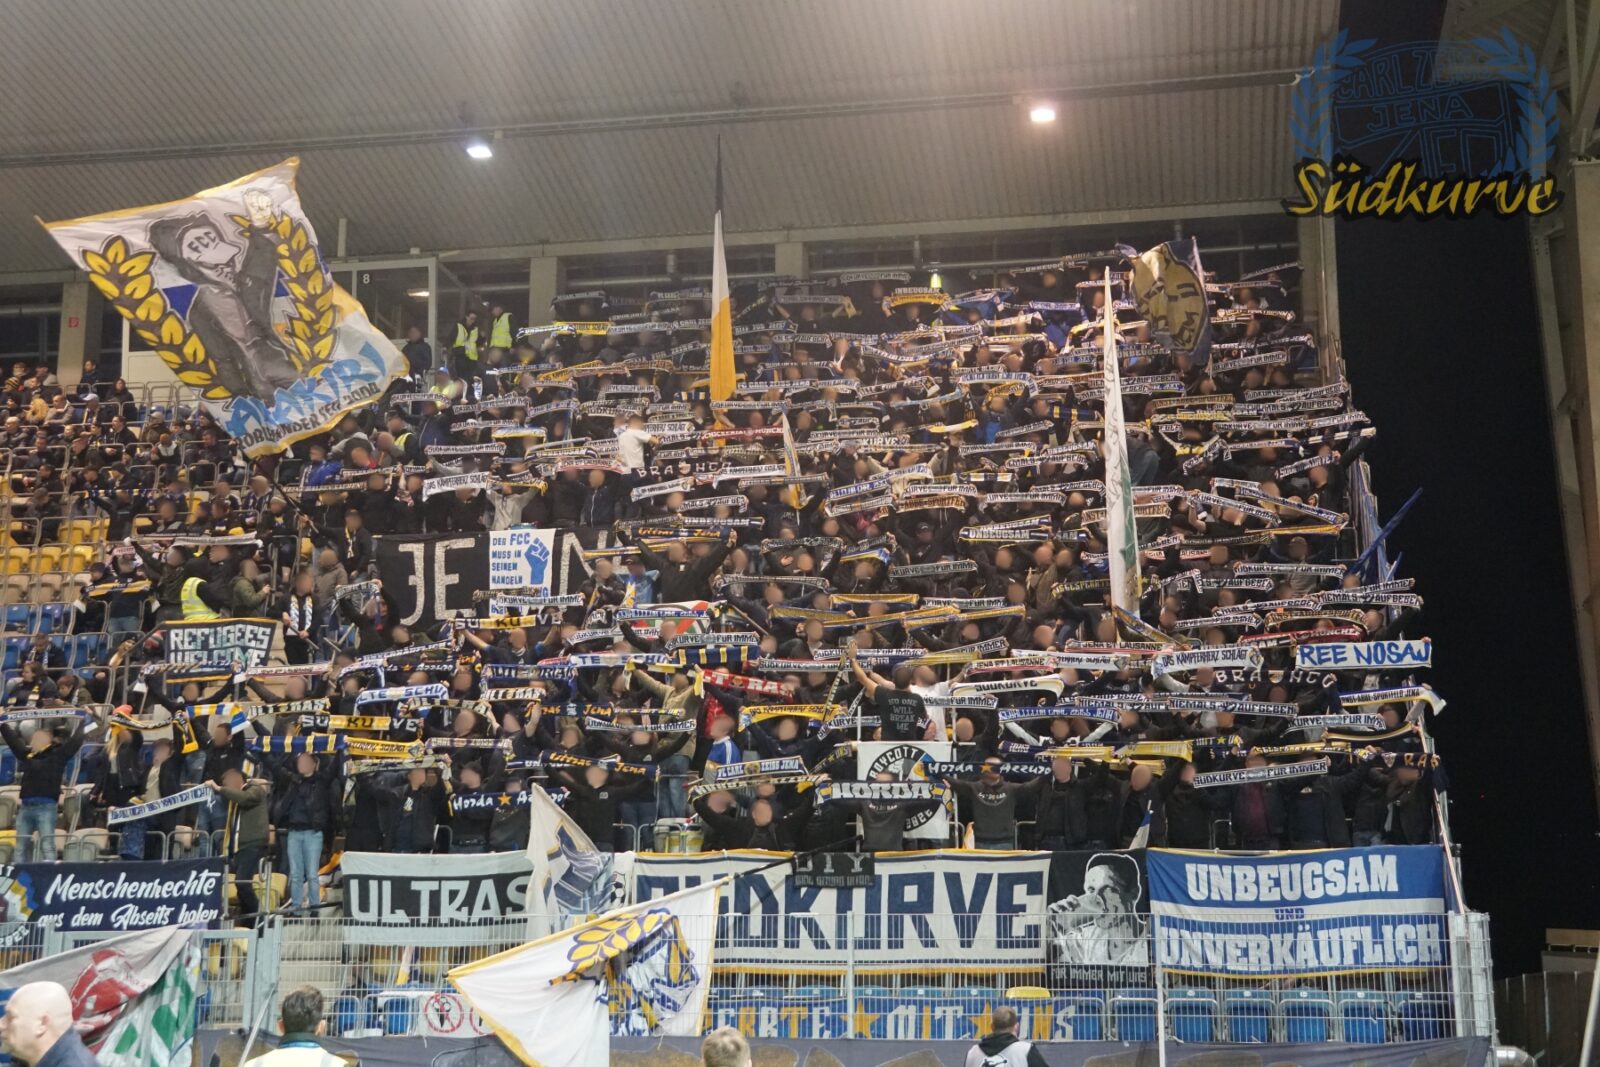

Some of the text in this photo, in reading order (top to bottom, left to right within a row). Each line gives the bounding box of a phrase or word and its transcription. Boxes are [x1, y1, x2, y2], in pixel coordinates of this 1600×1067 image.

[188, 231, 217, 254] FCC
[363, 273, 370, 284] 8
[493, 533, 530, 545] DER FCC
[492, 551, 511, 559] MUSS
[492, 576, 523, 584] HANDELN
[170, 623, 271, 651] REFUGEES
[1302, 641, 1431, 666] REE NOSAJ
[889, 698, 903, 706] NO
[893, 706, 913, 715] WILL
[890, 715, 915, 724] BREAK
[897, 725, 909, 734] ME
[718, 759, 799, 777] FC CARL ZEISS JENA
[927, 763, 974, 775] Horda
[1194, 772, 1245, 786] SÜDKURVE
[1289, 762, 1327, 775] IMMER
[831, 782, 932, 799] HORDA
[452, 796, 494, 811] Horda
[1184, 854, 1398, 902] UNBEUGSAM
[44, 869, 222, 905] Menschenrechte
[349, 876, 531, 924] ULTRAS
[38, 911, 65, 929] aus
[71, 906, 103, 928] dem
[112, 903, 175, 930] Abseits
[636, 871, 1044, 950] SDKURVE
[1275, 908, 1305, 922] UND
[1161, 923, 1442, 972] UNVERKÄUFLICH
[1070, 967, 1103, 980] IMMER
[1107, 967, 1126, 981] MIT
[887, 1004, 964, 1040] MIT
